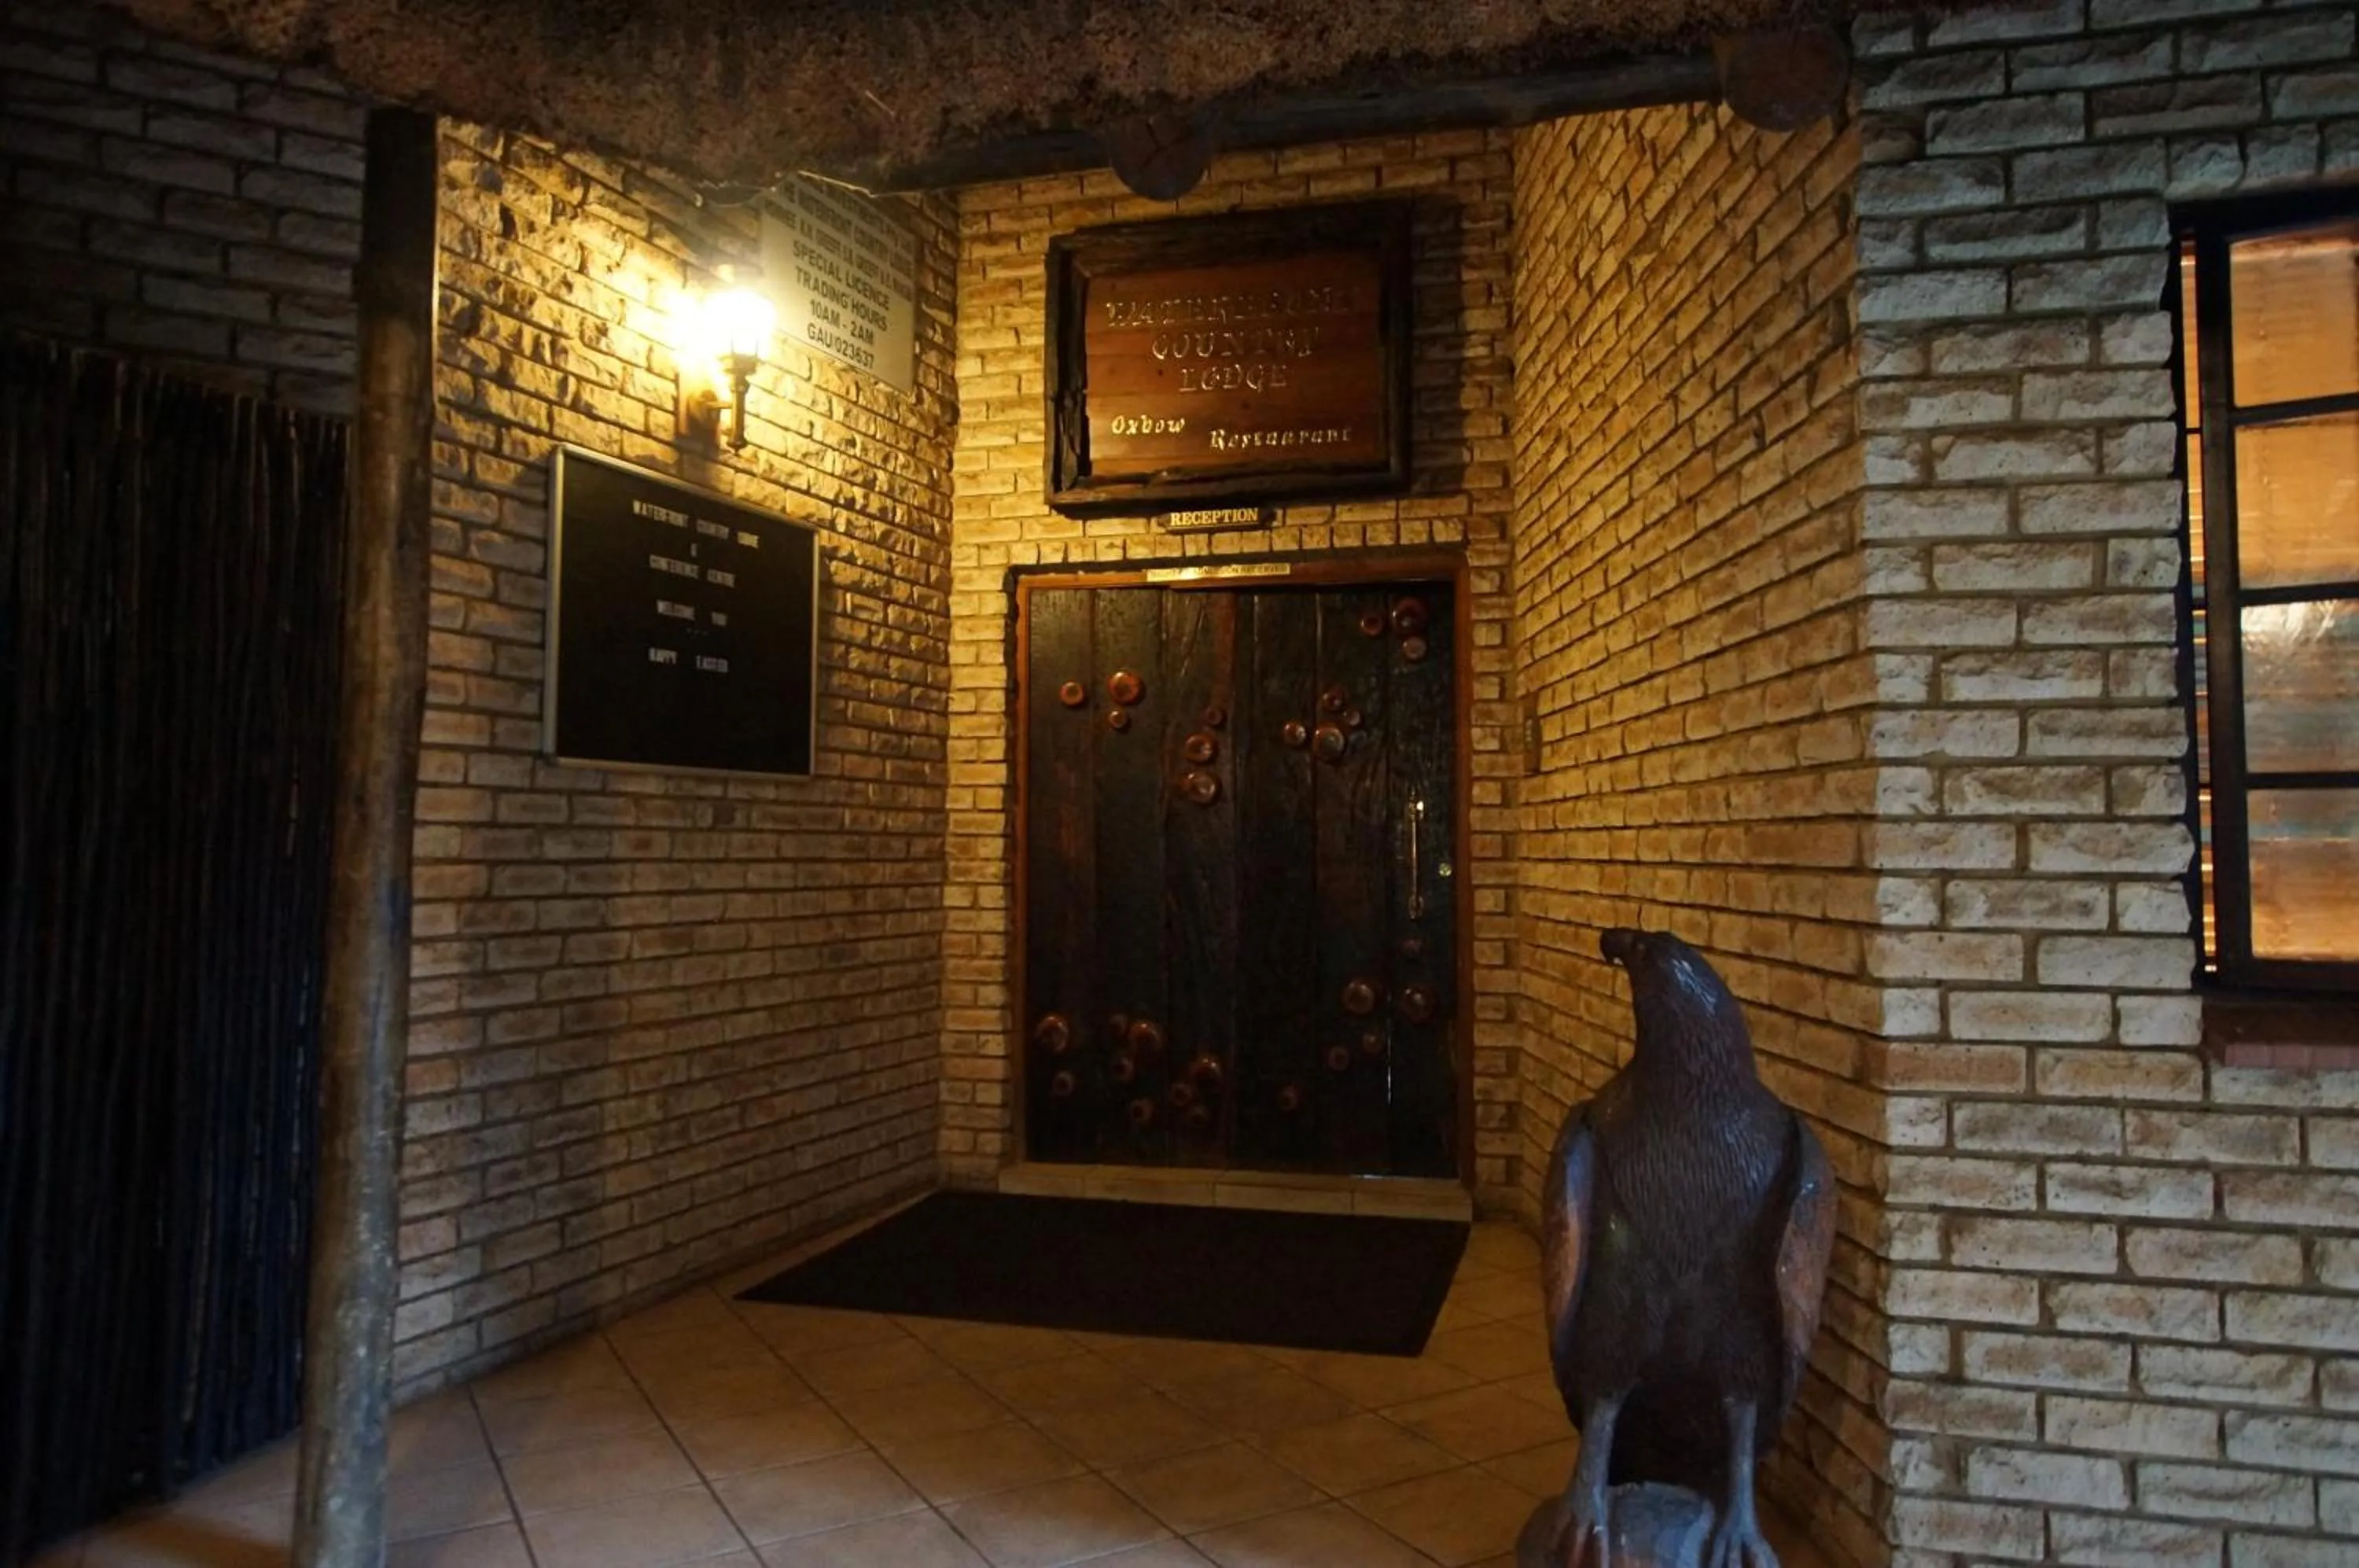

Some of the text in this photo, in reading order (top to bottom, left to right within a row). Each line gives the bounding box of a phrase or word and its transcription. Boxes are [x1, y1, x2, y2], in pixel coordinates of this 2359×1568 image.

[792, 240, 841, 283] SPECIAL
[845, 271, 890, 311] LICENCE
[796, 266, 848, 309] TRADING
[852, 300, 888, 332] HOURS
[808, 322, 833, 348] GAU
[811, 299, 841, 329] 10AM
[850, 320, 874, 345] 2AM
[1111, 414, 1186, 435] Oxbow
[1170, 508, 1259, 527] RECEPTION
